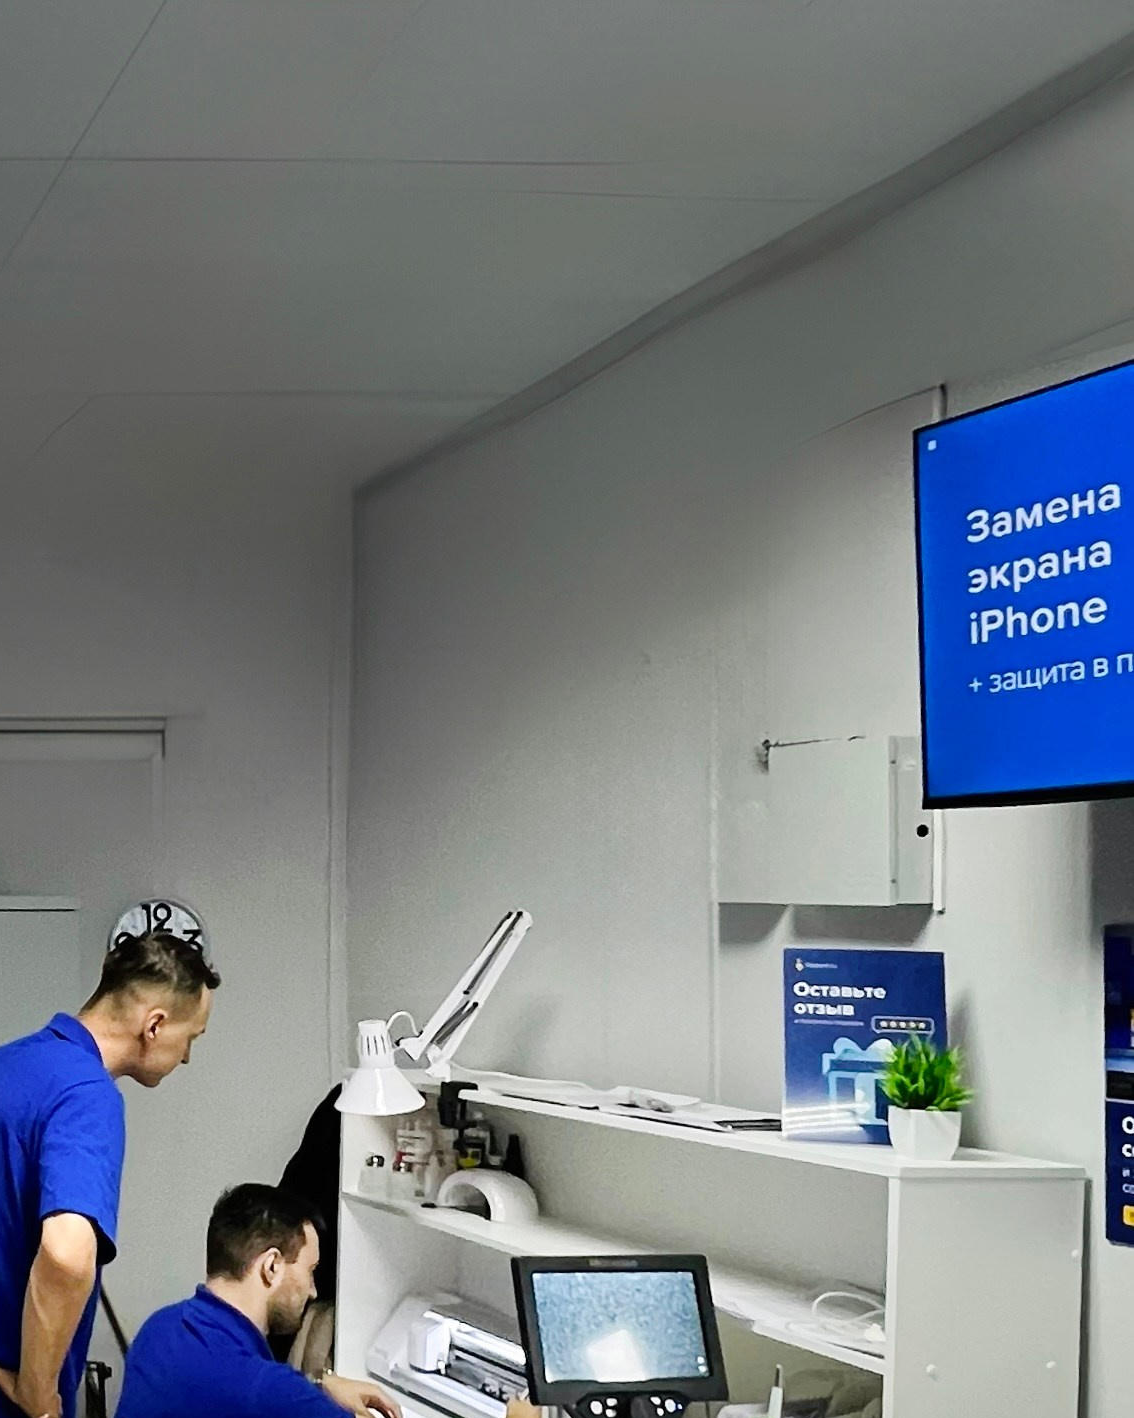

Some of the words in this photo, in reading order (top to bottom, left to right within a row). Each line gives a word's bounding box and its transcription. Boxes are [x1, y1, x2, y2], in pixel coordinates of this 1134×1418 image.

[966, 483, 1122, 543] Замена
[968, 540, 1113, 594] экрана
[970, 596, 1108, 645] iPhone
[989, 660, 1085, 693] защита
[1093, 657, 1109, 677] в
[141, 903, 173, 933] 12
[793, 981, 887, 1000] Оставьте
[793, 1002, 855, 1016] отзыв
